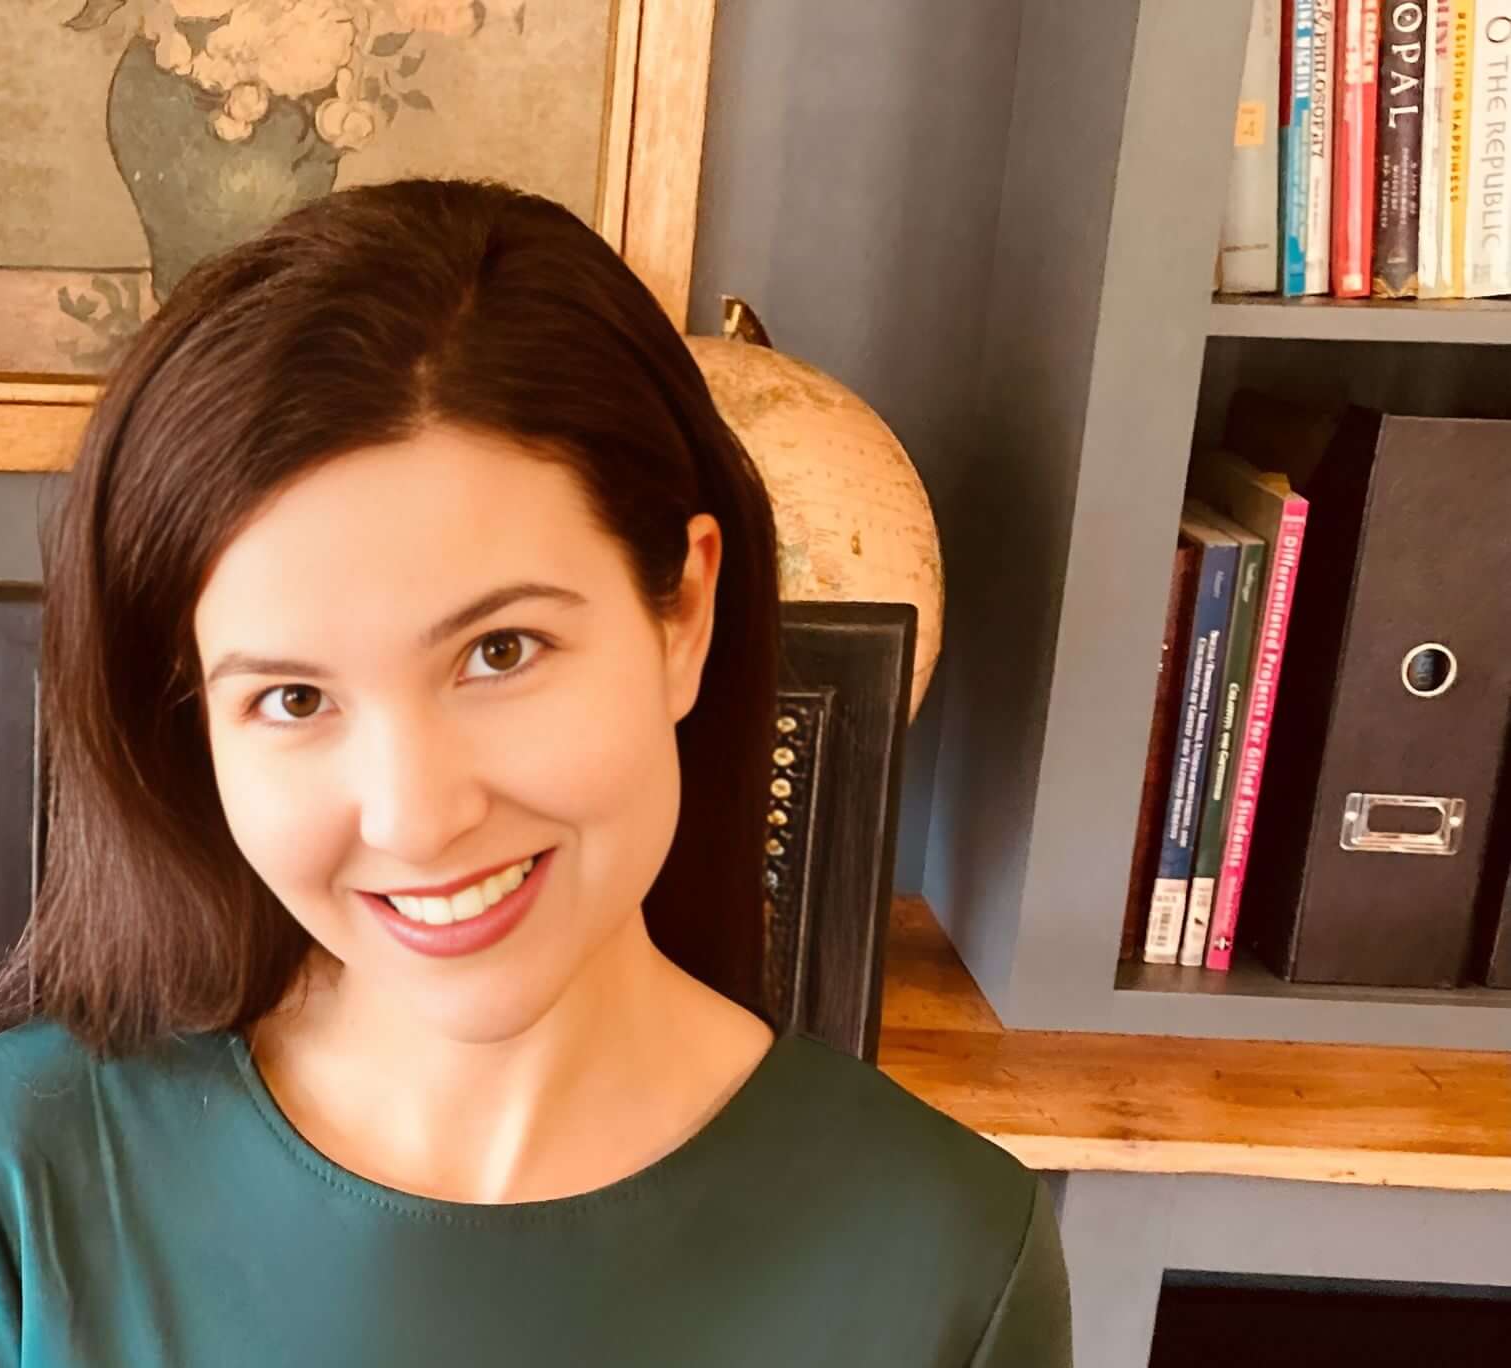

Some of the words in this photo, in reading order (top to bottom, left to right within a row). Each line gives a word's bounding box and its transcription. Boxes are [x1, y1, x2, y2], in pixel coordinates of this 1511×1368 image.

[1312, 31, 1328, 158] PHILOSOPHY
[1453, 12, 1467, 101] RESISTING
[1486, 55, 1510, 112] THE
[1449, 109, 1466, 203] HAPPINESS
[1480, 120, 1508, 250] REPUBLIC
[1265, 535, 1298, 650] Differentiated
[1253, 652, 1280, 718] Projects
[1241, 746, 1262, 797] Gifted
[1250, 719, 1267, 745] for
[1228, 799, 1253, 868] Students
